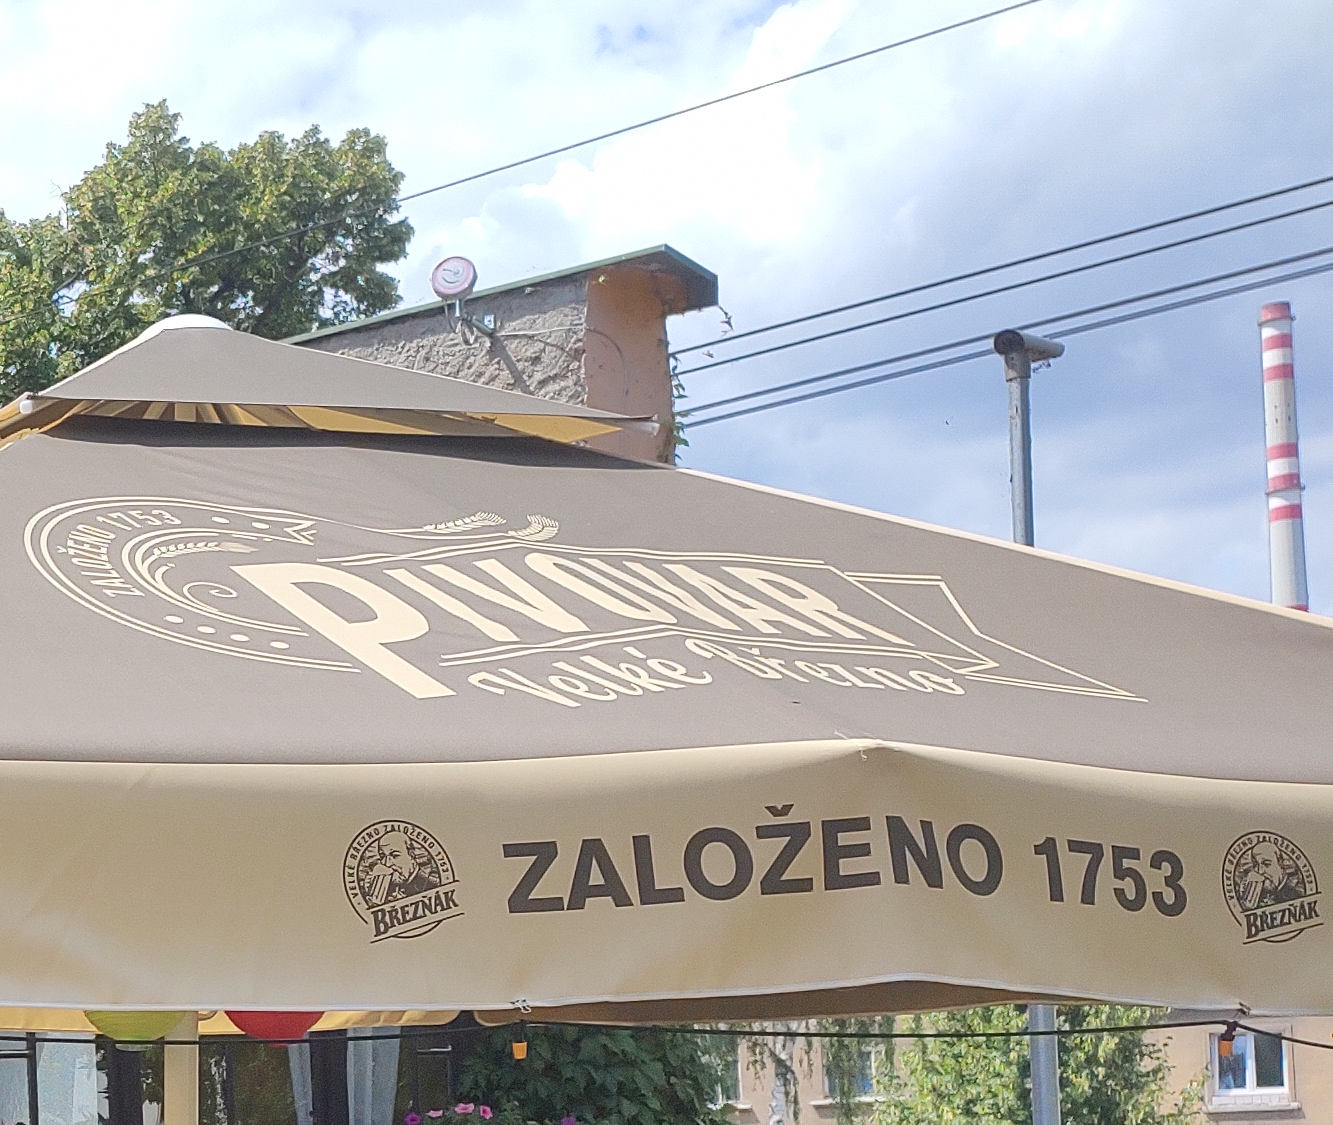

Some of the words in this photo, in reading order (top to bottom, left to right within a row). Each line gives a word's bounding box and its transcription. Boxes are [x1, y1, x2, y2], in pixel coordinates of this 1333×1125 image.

[95, 509, 182, 531] 1753
[56, 524, 145, 598] ZALOŽENO
[232, 552, 917, 700] PIVOVAR
[467, 646, 713, 708] Velké
[684, 638, 967, 697] Březno
[434, 850, 450, 874] 1753
[501, 803, 1004, 915] ZALOŽENO
[1033, 836, 1189, 917] 1753
[371, 889, 460, 938] BŘEZŇÁK
